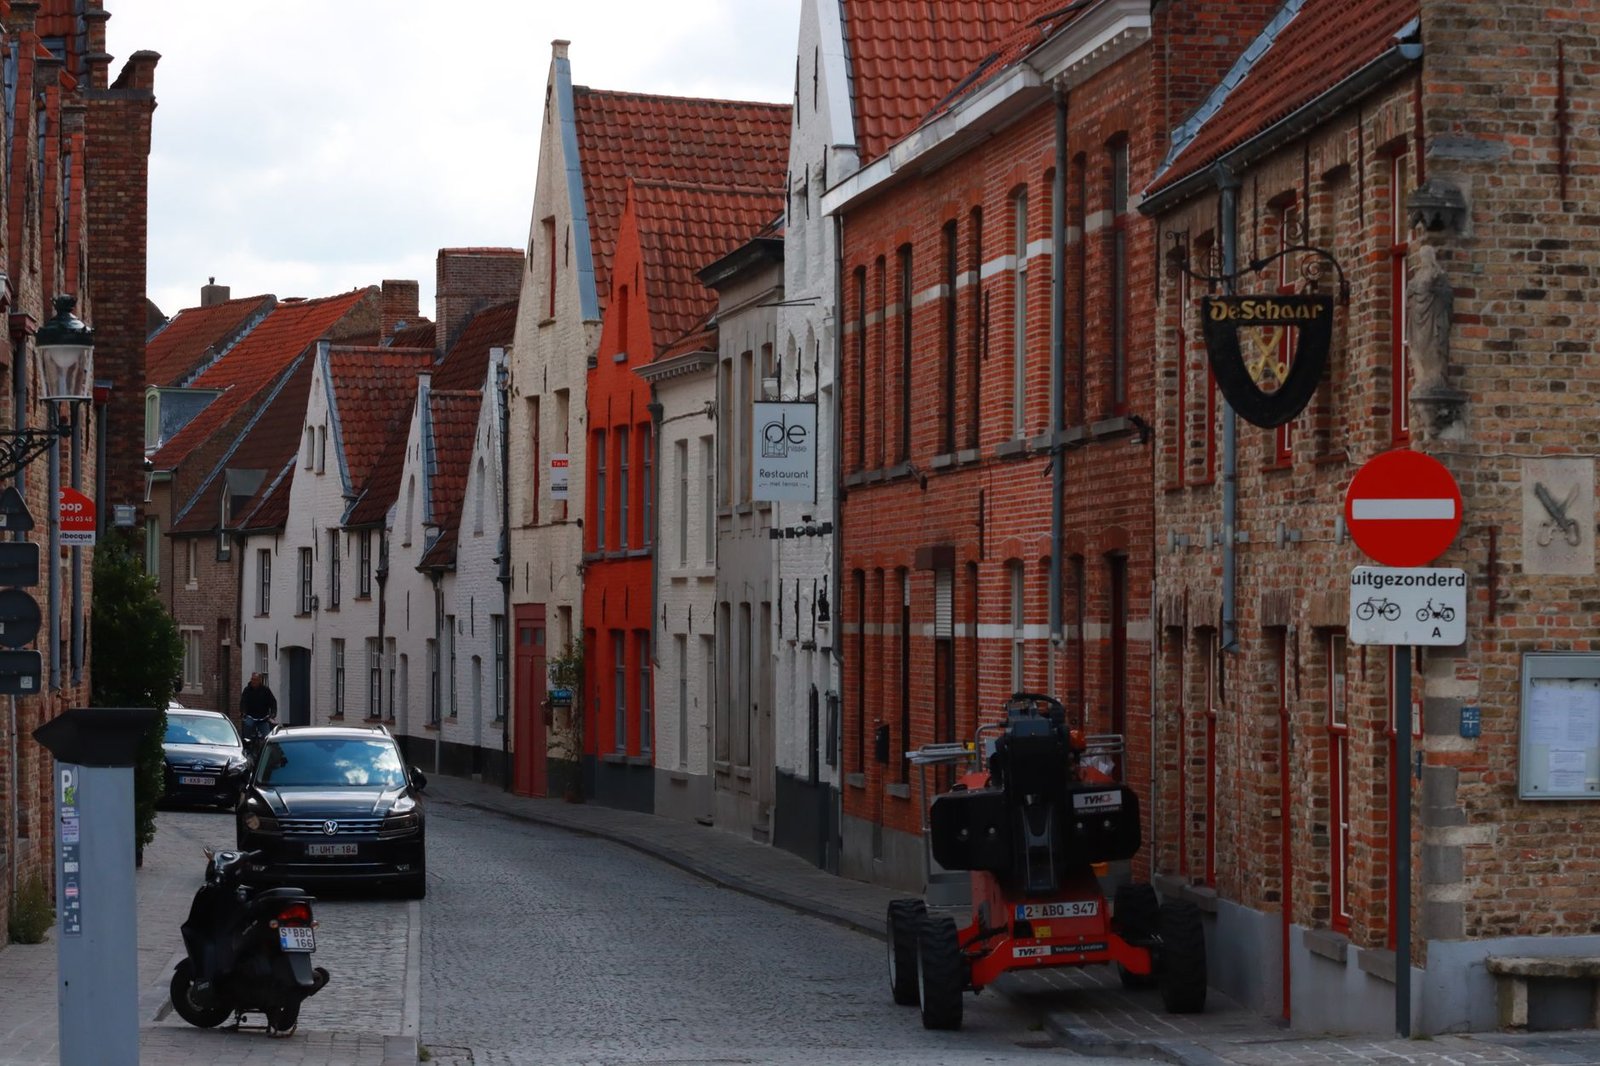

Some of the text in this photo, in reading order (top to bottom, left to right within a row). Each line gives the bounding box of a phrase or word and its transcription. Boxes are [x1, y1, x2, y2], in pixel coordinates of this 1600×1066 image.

[765, 412, 807, 445] de
[759, 468, 809, 479] Restaurant
[59, 503, 83, 513] oop
[1351, 572, 1465, 589] uitgezonderd
[1431, 627, 1442, 638] A
[1084, 795, 1102, 804] TVH
[295, 938, 313, 948] 166
[1018, 948, 1035, 956] TVH
